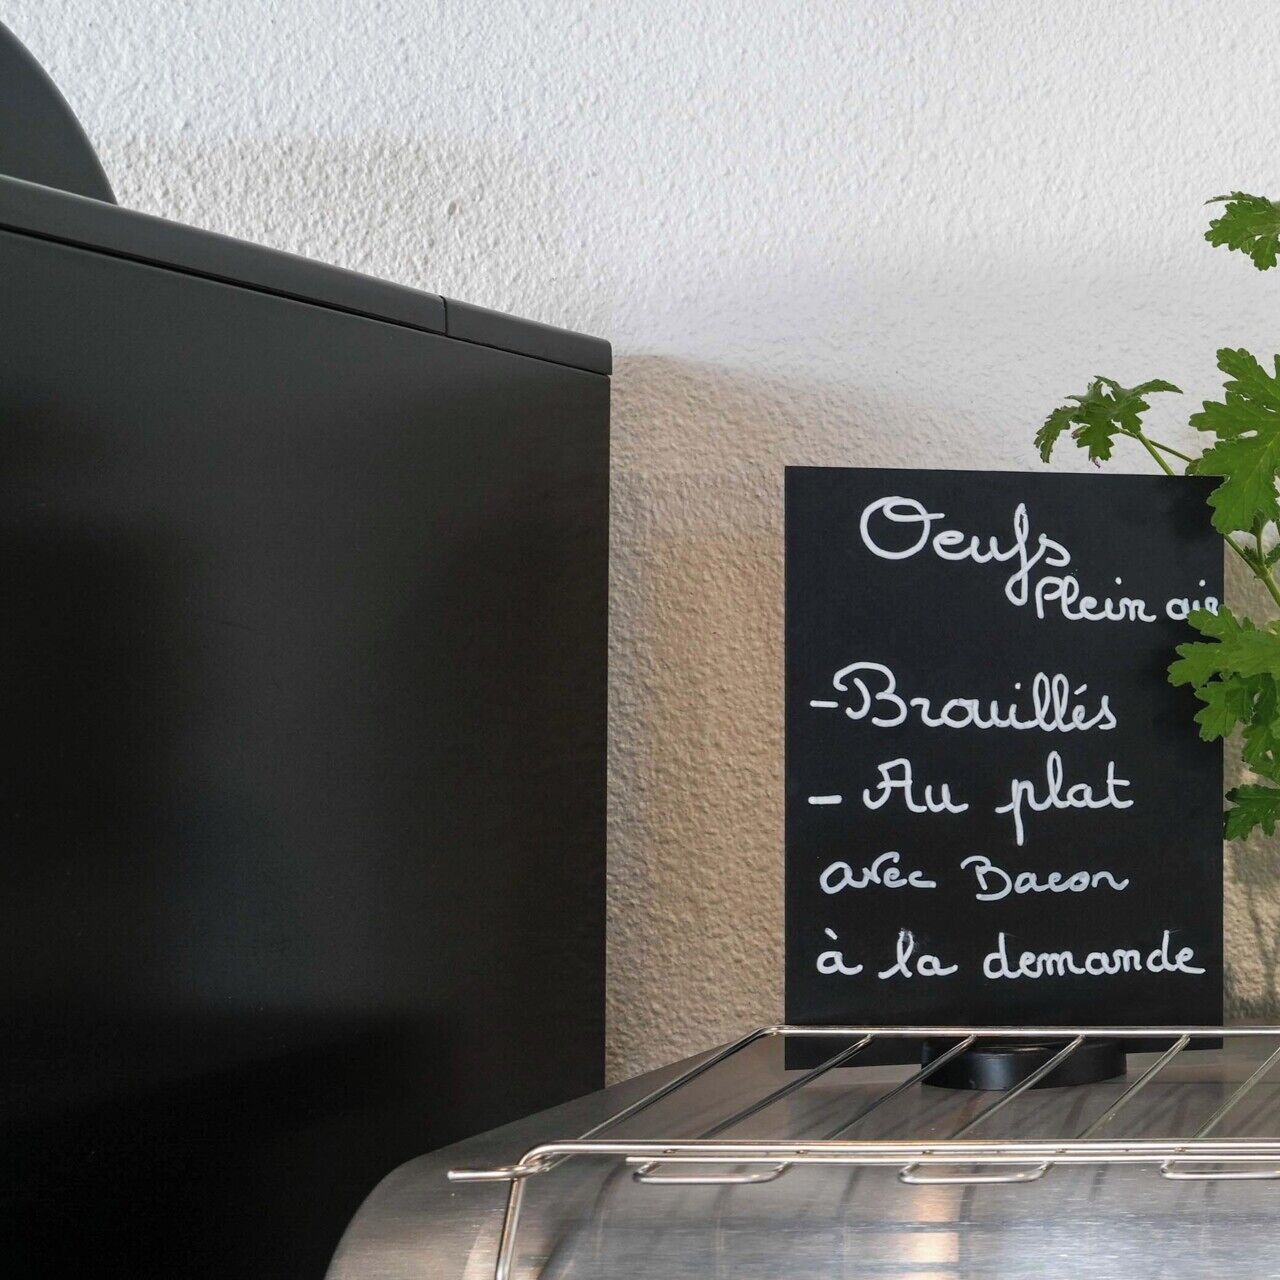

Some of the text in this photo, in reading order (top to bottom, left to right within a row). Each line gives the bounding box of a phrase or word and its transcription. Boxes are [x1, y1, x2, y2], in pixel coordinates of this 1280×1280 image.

[859, 495, 1071, 606] Oeufs
[862, 757, 969, 814] Au
[994, 750, 1135, 847] plat
[819, 851, 1130, 902] avec Bacon
[816, 927, 1207, 980] à la demande
